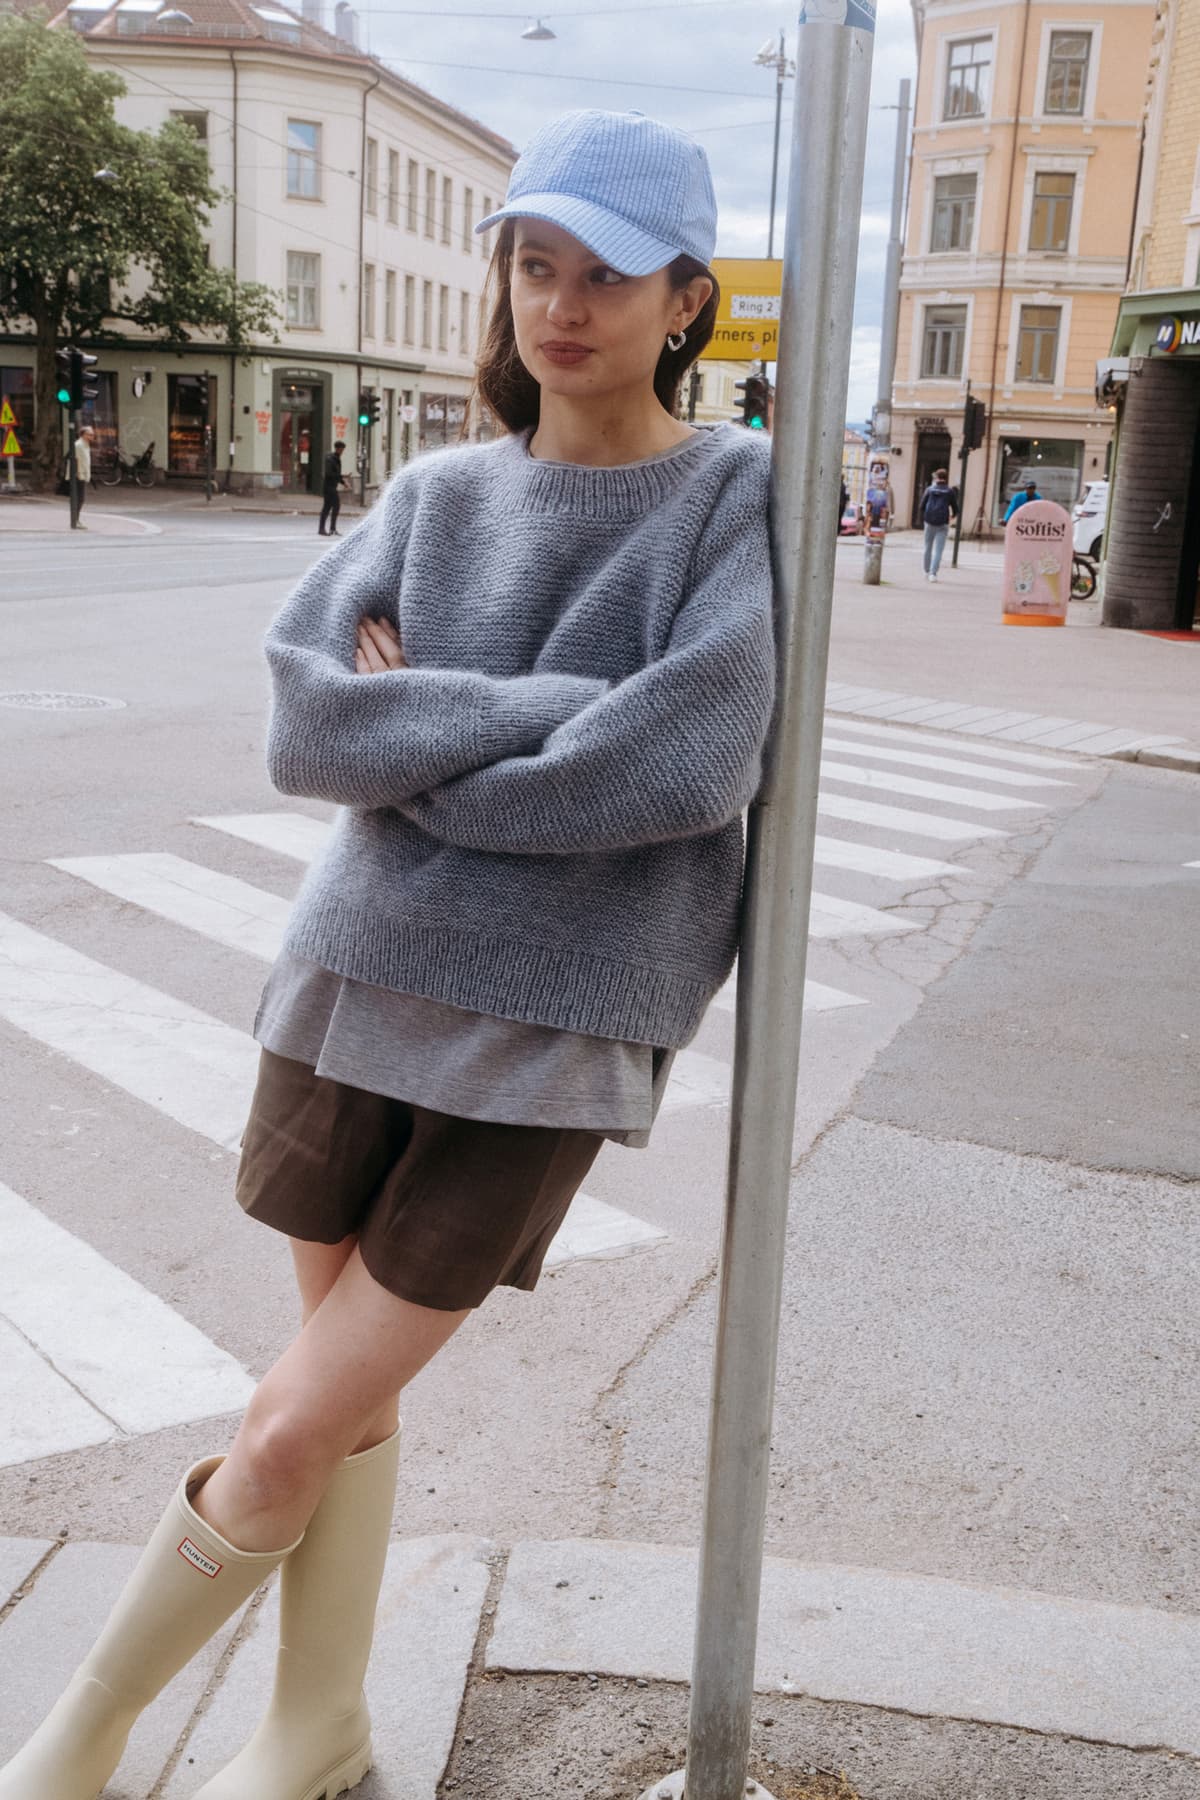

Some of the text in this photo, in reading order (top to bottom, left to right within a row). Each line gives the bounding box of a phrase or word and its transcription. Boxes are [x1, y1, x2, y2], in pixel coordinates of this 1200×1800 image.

[739, 301, 774, 314] Ring 2
[1016, 522, 1065, 537] softis!
[183, 1544, 216, 1572] HUNTER
